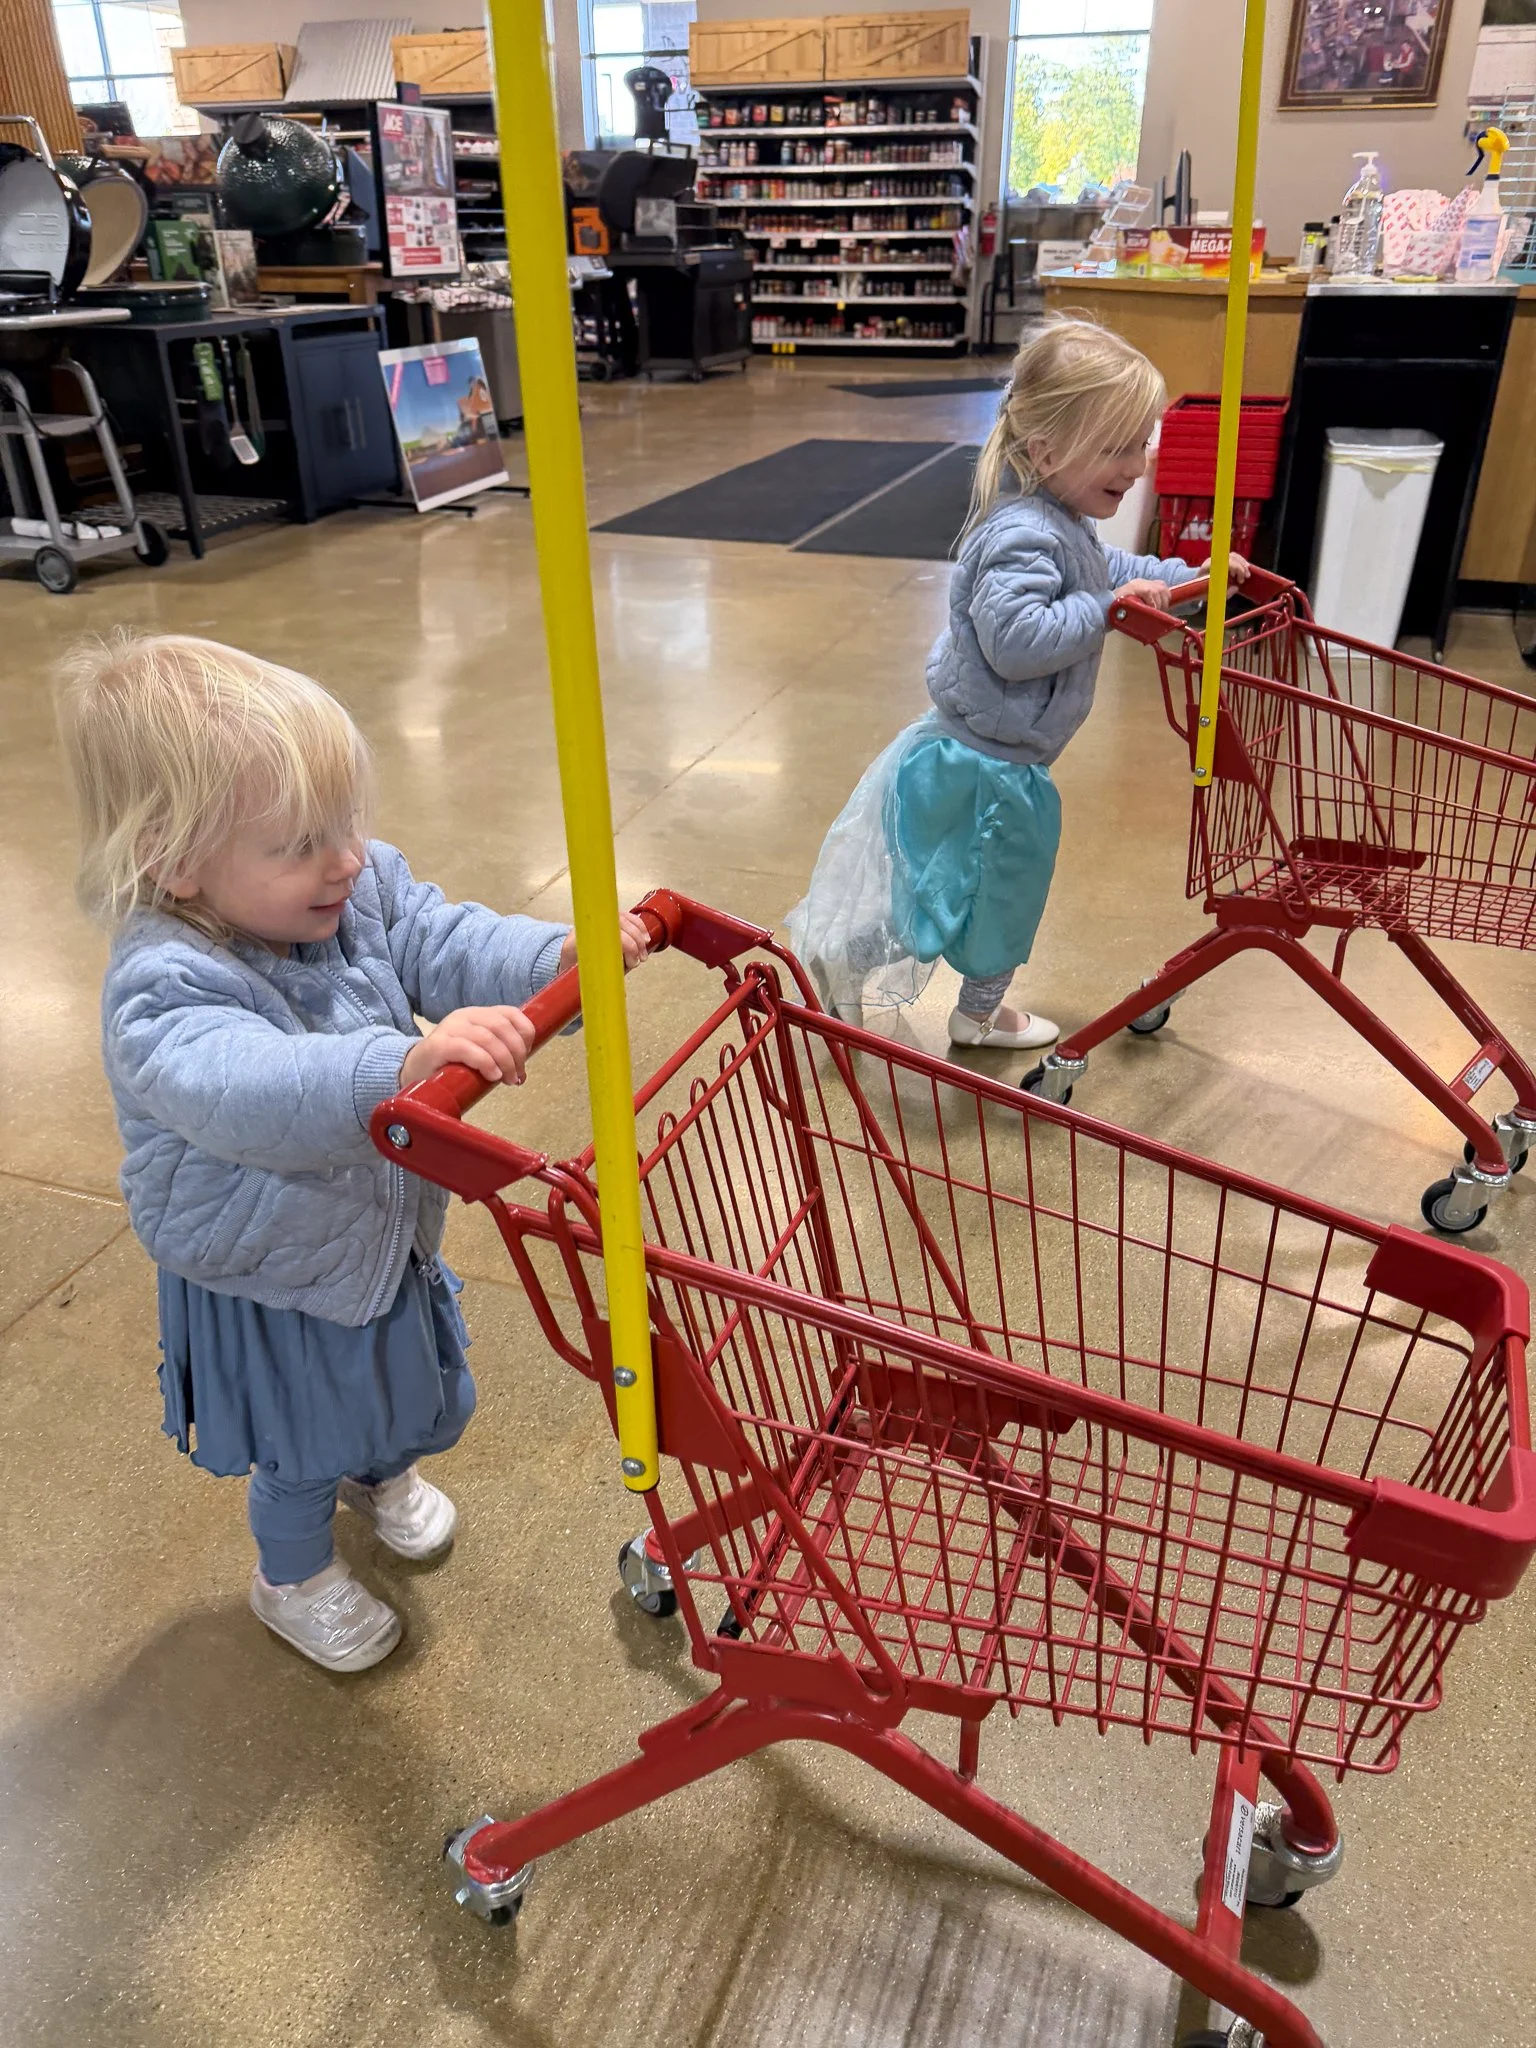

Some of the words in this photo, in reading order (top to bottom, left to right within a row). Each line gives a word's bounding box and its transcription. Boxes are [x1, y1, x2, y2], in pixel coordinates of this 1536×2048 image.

[383, 113, 403, 131] ACE
[1179, 515, 1214, 541] AC
[1235, 1816, 1247, 1855] versacart
